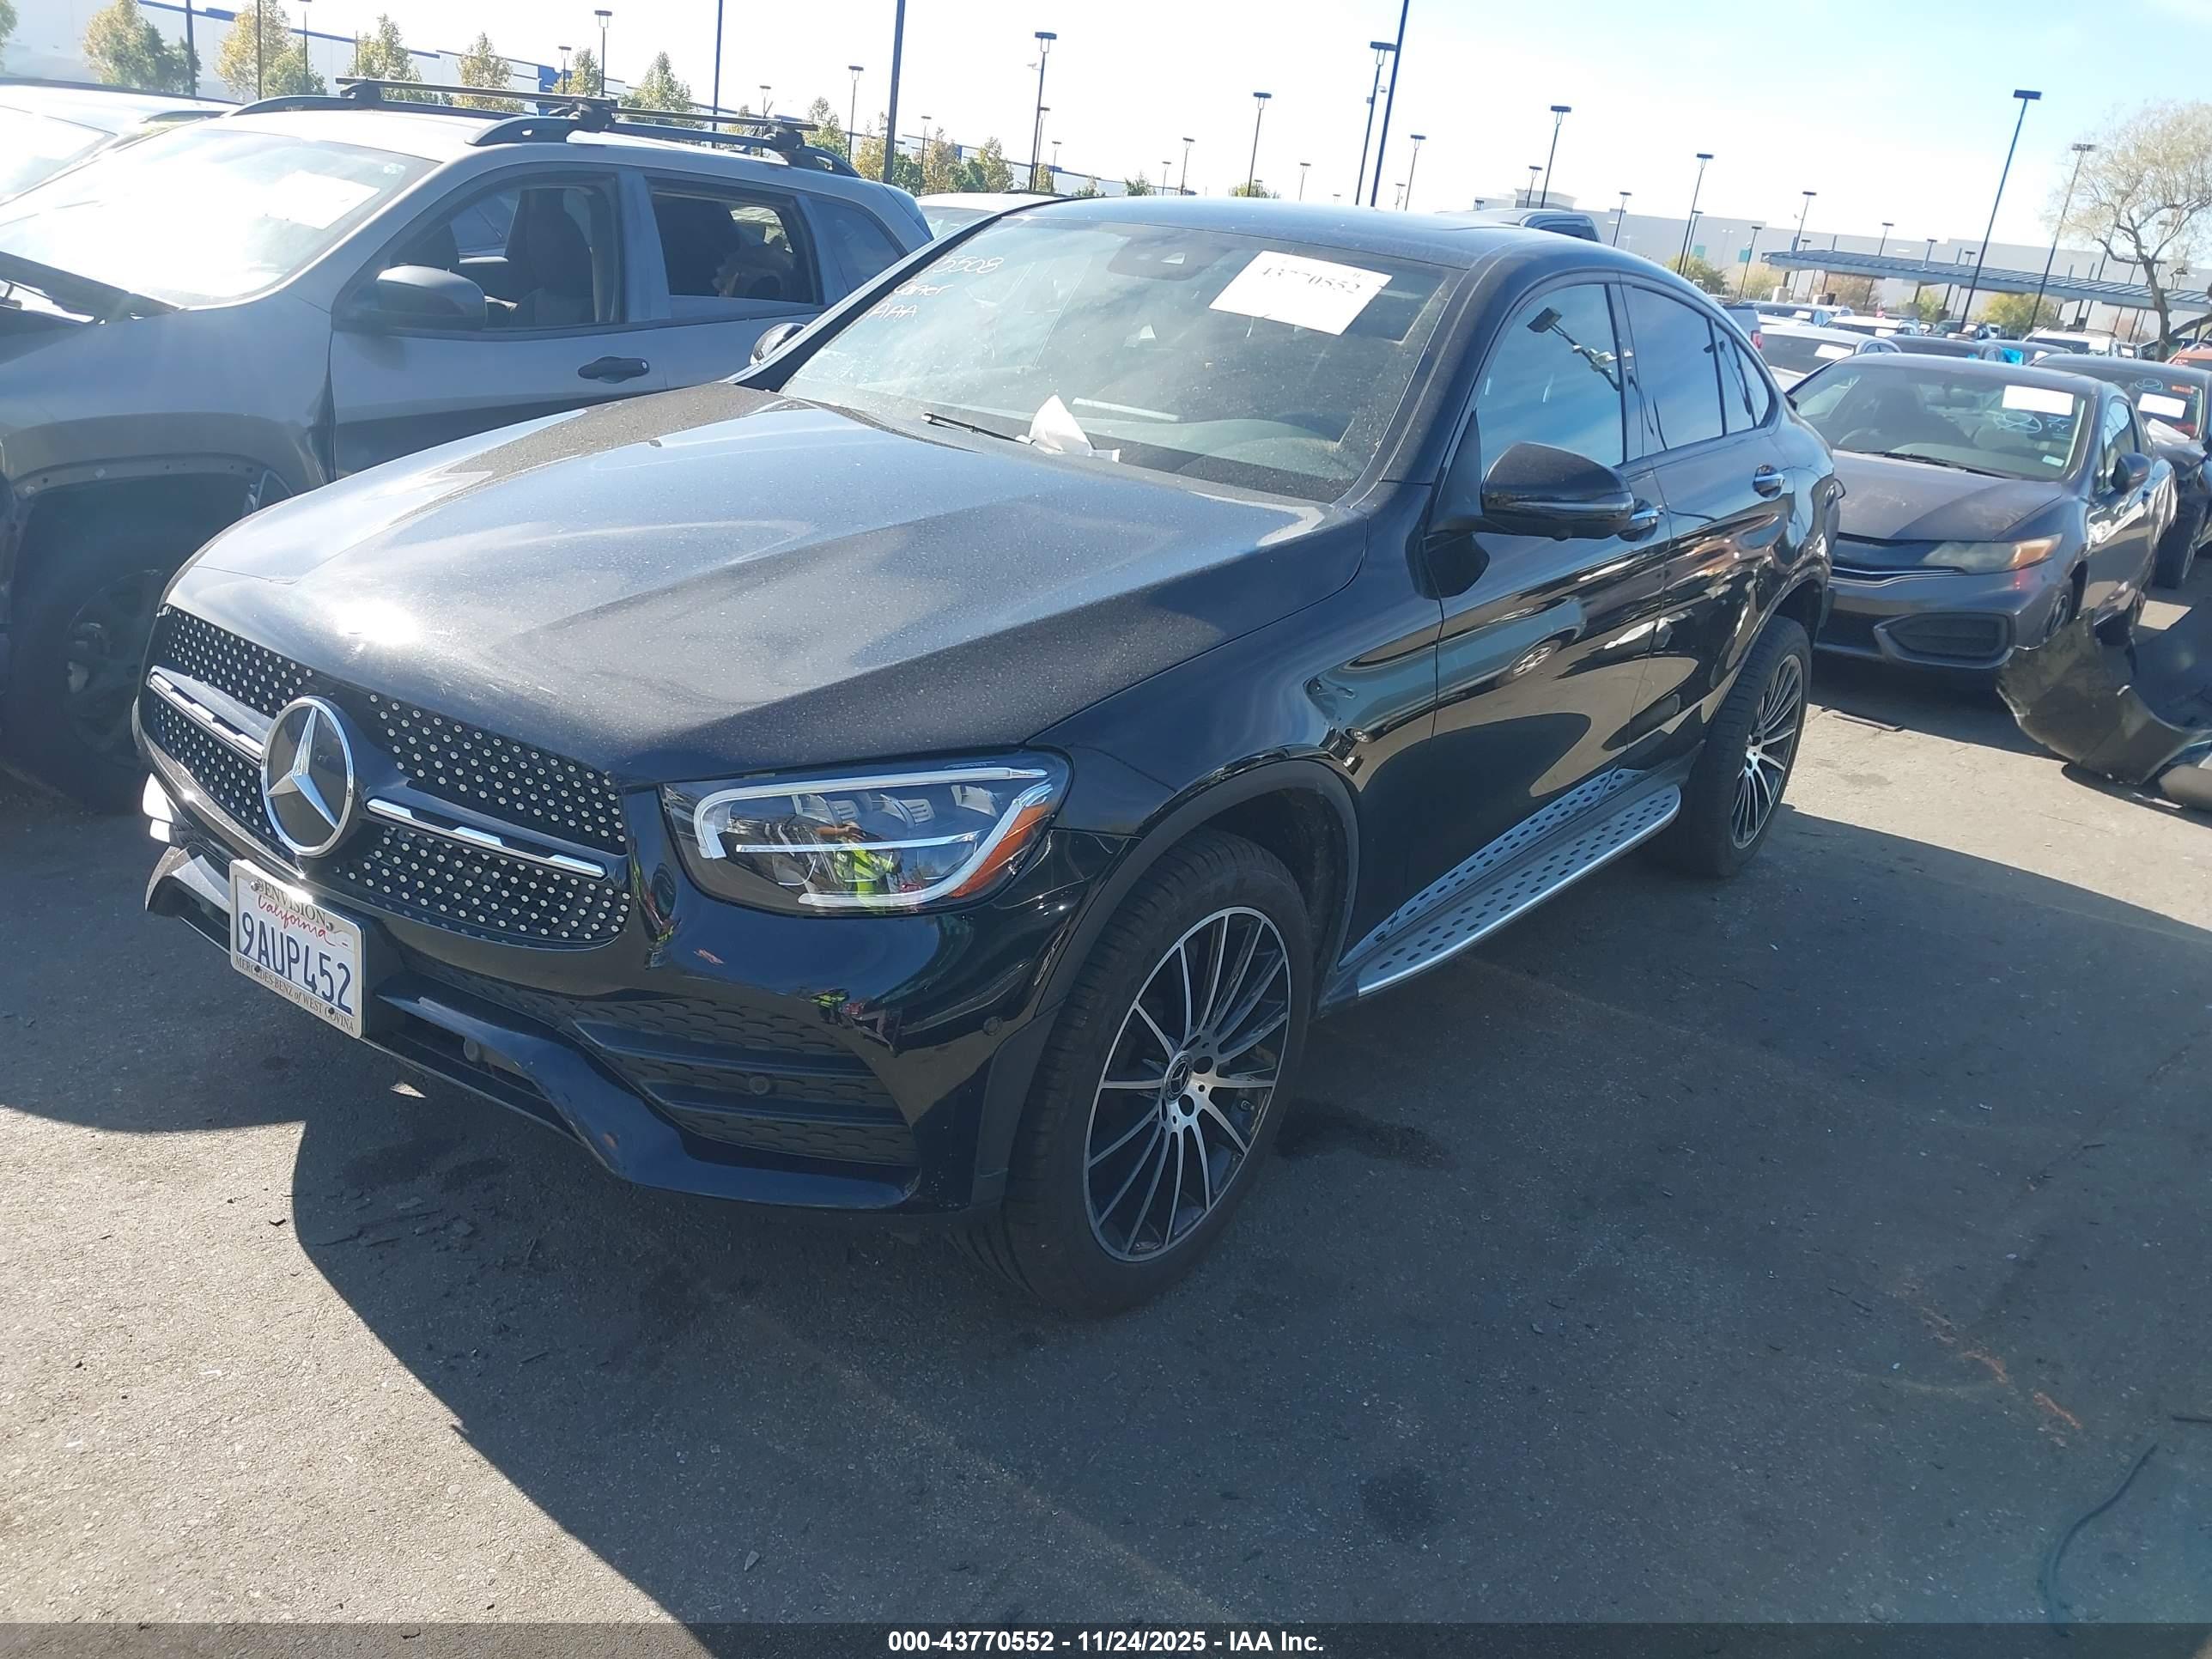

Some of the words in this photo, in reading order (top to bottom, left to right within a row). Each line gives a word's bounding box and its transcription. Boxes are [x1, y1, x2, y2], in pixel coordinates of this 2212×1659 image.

[258, 895, 336, 946] California
[264, 881, 325, 927] ENVISION
[241, 911, 353, 1017] 9AUP452
[295, 992, 301, 1004] of
[303, 994, 324, 1014] WEST
